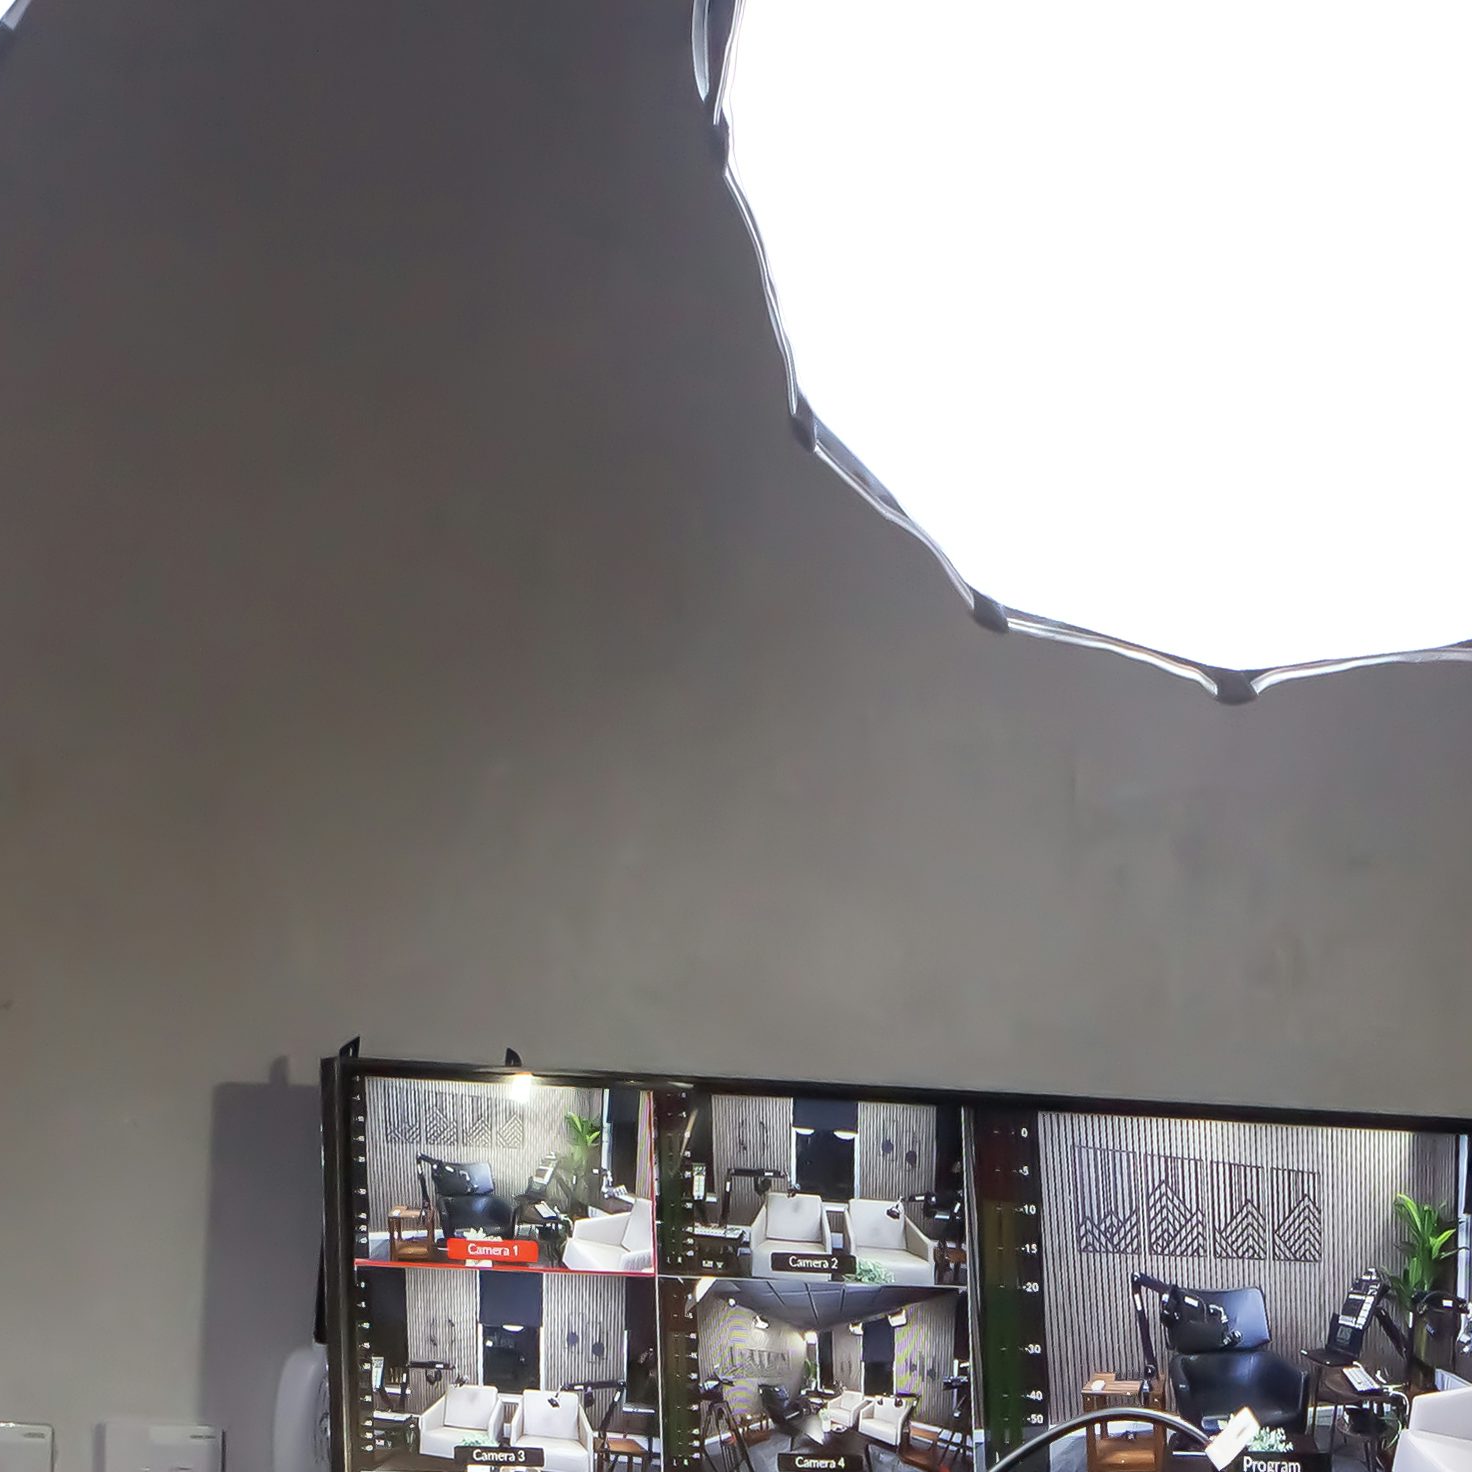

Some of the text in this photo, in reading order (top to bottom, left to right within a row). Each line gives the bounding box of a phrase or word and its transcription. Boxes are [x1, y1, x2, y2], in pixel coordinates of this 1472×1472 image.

[1020, 1127, 1028, 1138] 0
[1021, 1205, 1036, 1215] -10
[468, 1243, 519, 1257] Camera 1
[1022, 1244, 1038, 1254] -15
[788, 1256, 839, 1270] Camera 2
[1023, 1283, 1039, 1293] -20
[1025, 1345, 1041, 1354] -30
[1027, 1391, 1043, 1401] -40
[1027, 1414, 1044, 1424] -50
[473, 1448, 526, 1463] Camera 3
[795, 1456, 846, 1469] Camera 4
